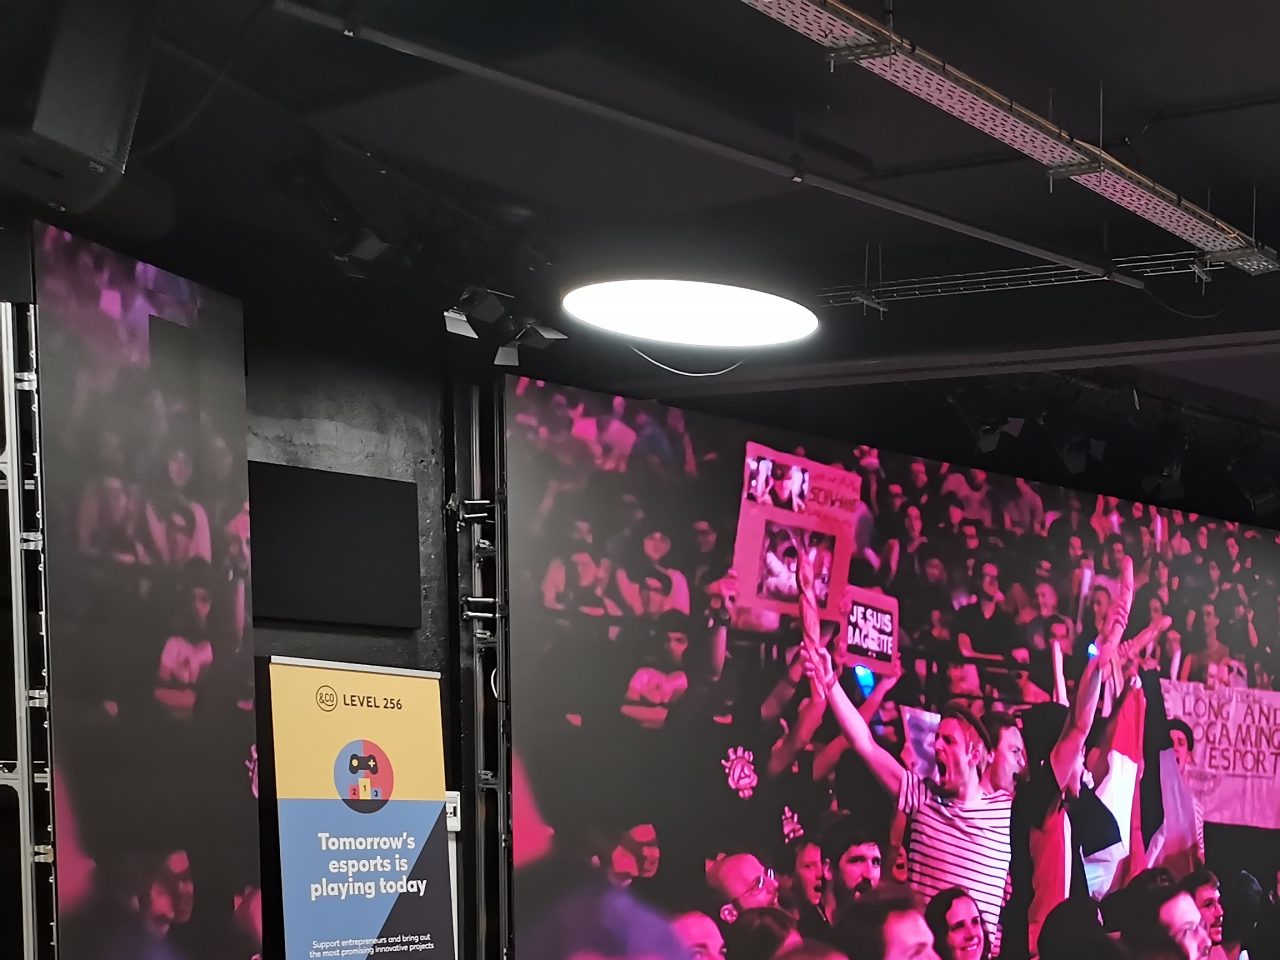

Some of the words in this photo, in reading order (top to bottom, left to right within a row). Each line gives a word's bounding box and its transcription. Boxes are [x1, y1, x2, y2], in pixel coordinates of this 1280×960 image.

[849, 605, 865, 623] JE
[866, 608, 892, 633] SUIS
[848, 625, 893, 655] BAGTTE
[343, 694, 380, 709] LEVEL
[383, 697, 403, 710] 256
[1182, 694, 1231, 721] LONG
[317, 832, 416, 851] Tomorrow's
[328, 855, 391, 877] esports
[395, 854, 408, 872] is
[310, 878, 376, 901] playing
[380, 876, 428, 896] today
[309, 950, 321, 958] the
[322, 949, 341, 957] most
[341, 946, 374, 957] promising
[375, 944, 408, 953] innovative
[409, 942, 434, 952] projects
[312, 940, 341, 950] Support
[341, 937, 387, 948] entrepreneurs
[388, 935, 401, 943] and
[402, 934, 419, 943] bring
[420, 933, 431, 941] out
